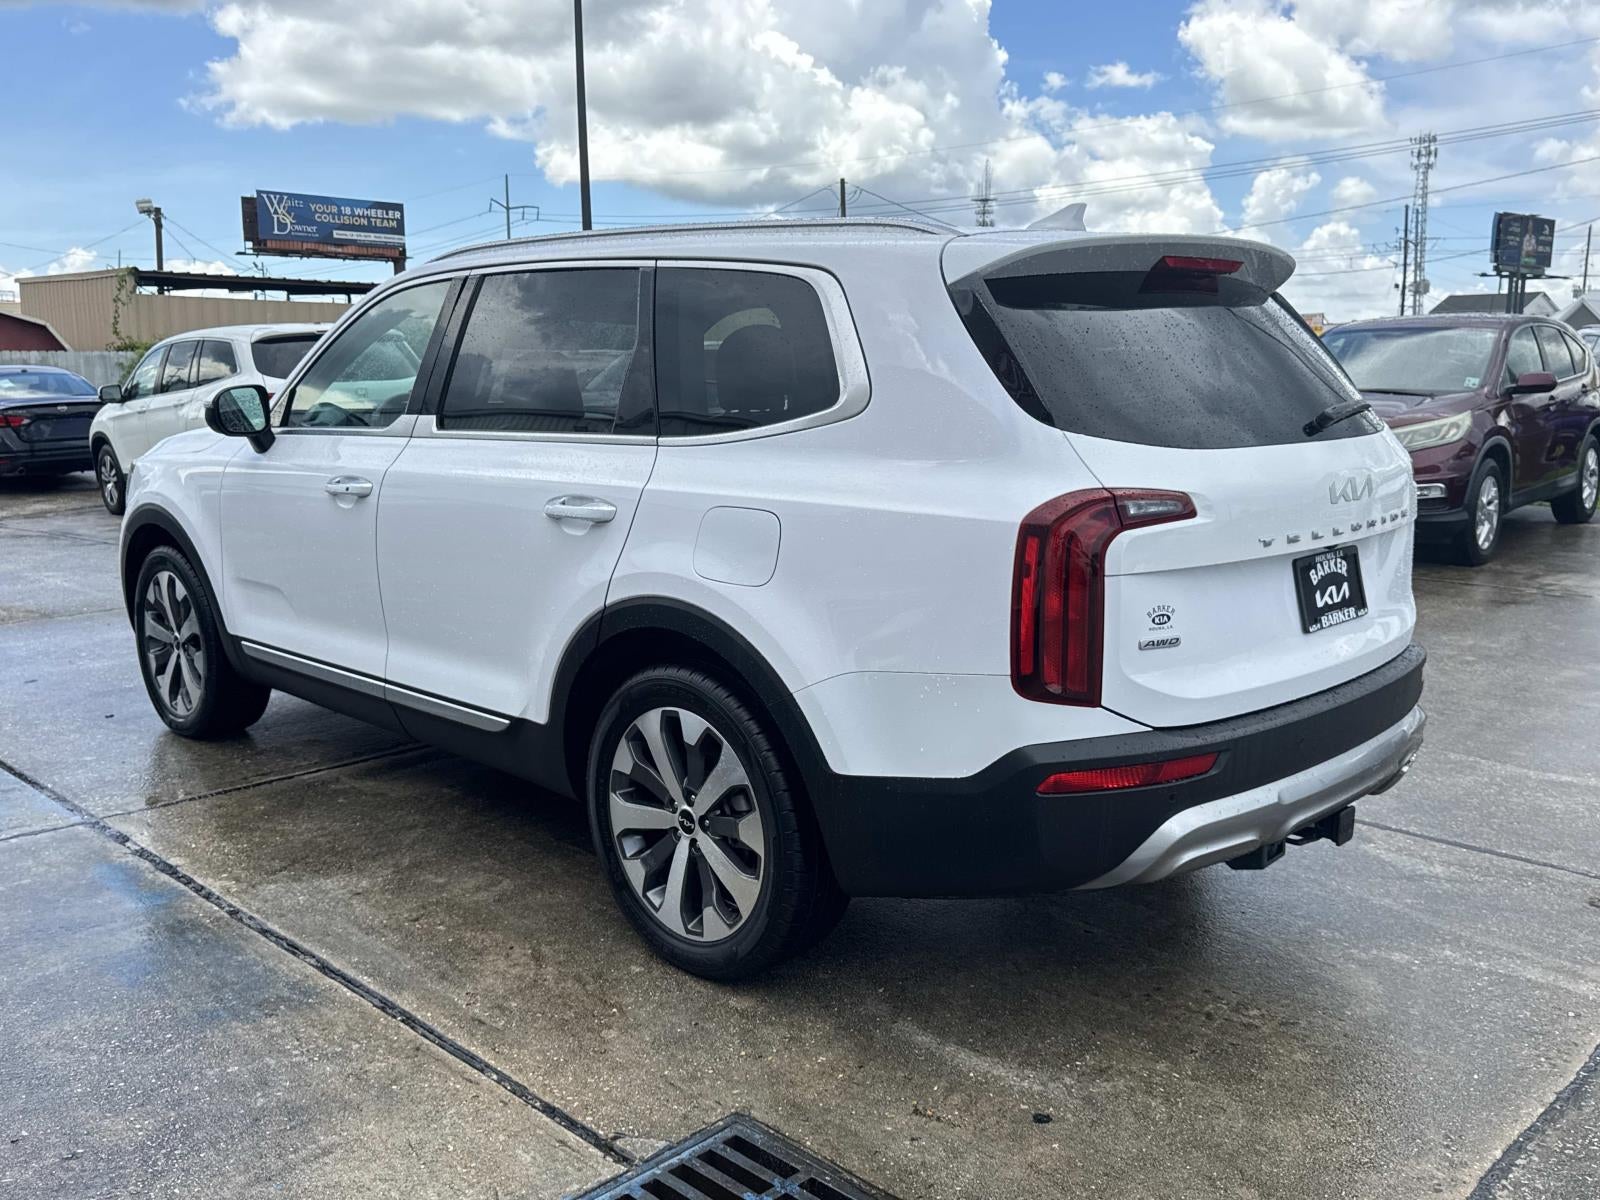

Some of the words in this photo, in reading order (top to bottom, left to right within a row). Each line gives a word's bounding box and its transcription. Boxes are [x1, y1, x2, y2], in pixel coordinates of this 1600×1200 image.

[309, 203, 338, 214] YOUR
[340, 206, 352, 215] 18
[353, 207, 401, 219] WHEELER
[272, 214, 318, 235] Downer
[314, 213, 368, 226] COLLISION
[370, 218, 398, 228] TEAM
[1258, 509, 1408, 548] TELLURIDE
[1309, 557, 1348, 586] BARKER
[1146, 605, 1176, 619] BARKER
[1154, 615, 1169, 624] KIA
[1320, 607, 1357, 628] BARKER
[1143, 637, 1180, 648] AWD
